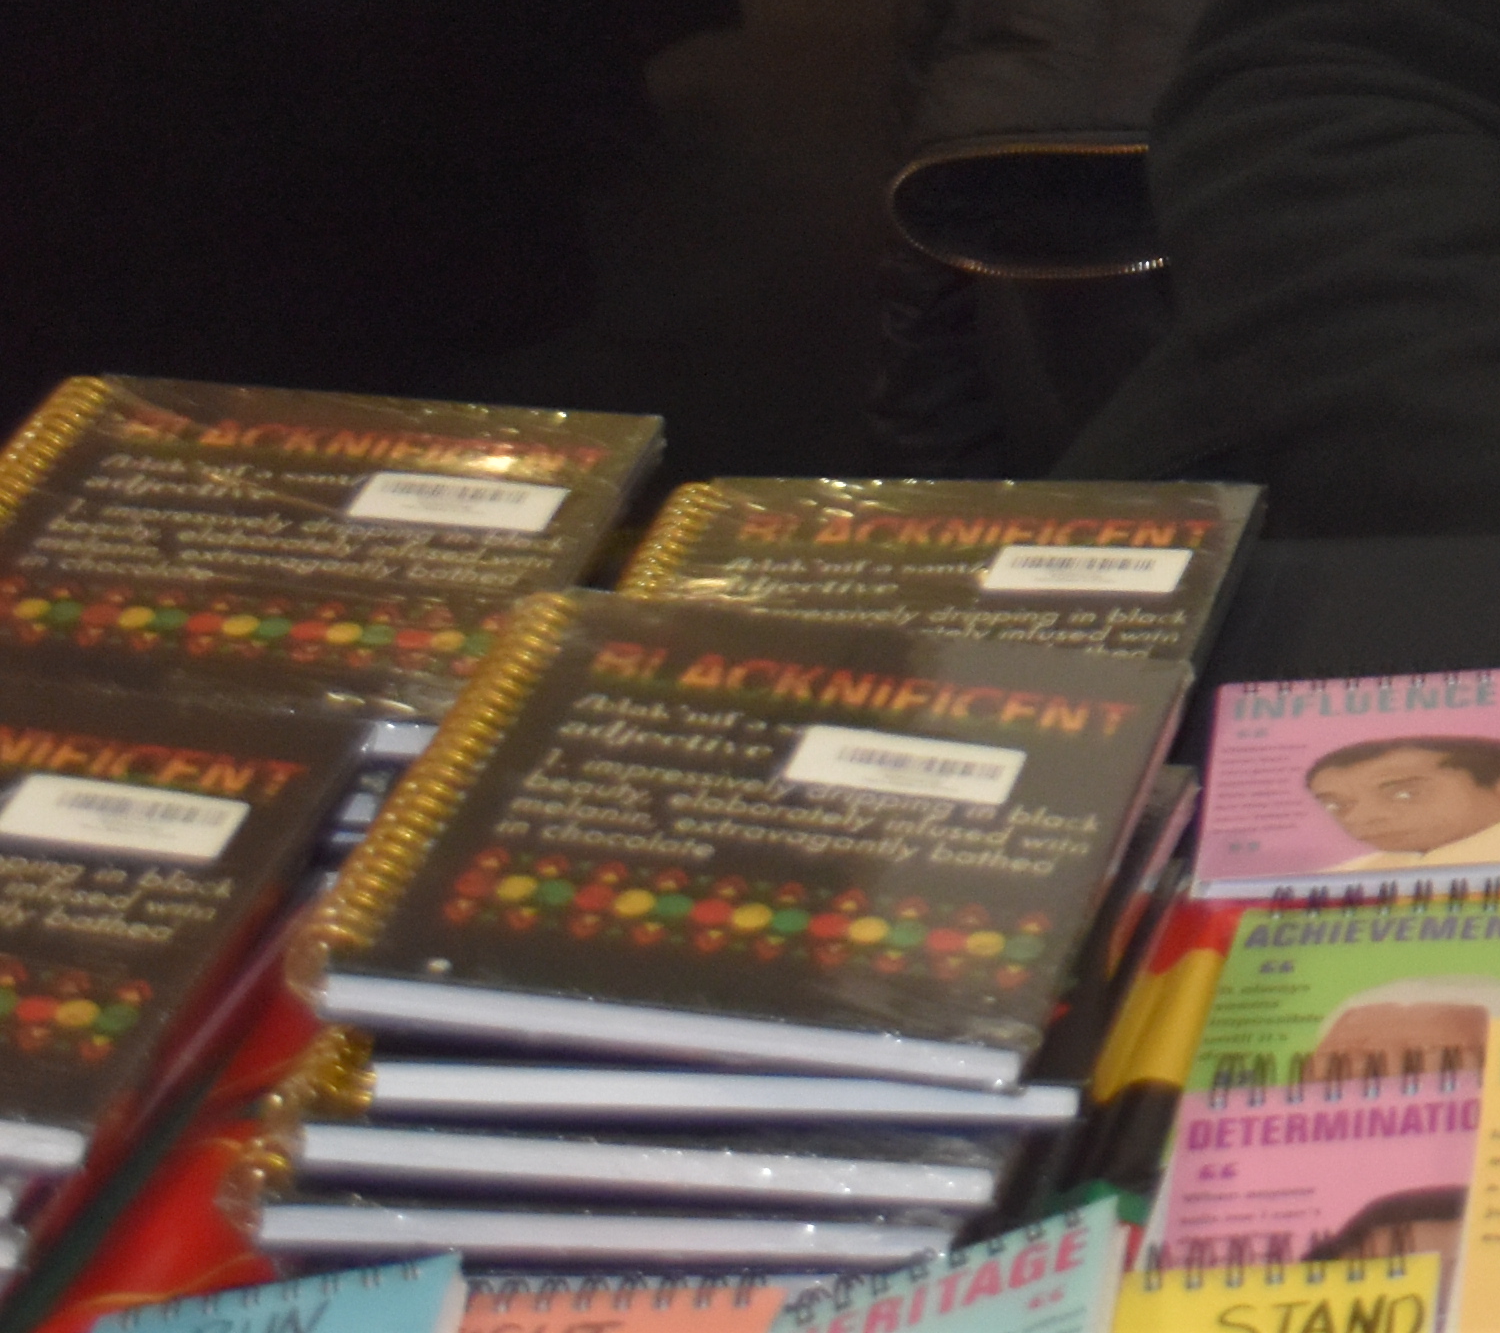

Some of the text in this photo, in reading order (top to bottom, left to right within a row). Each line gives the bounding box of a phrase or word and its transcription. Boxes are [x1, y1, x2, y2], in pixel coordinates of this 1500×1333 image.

[588, 639, 1144, 736] BLACKNIFICENT
[1232, 682, 1498, 722] INFLUENCE
[1007, 800, 1099, 834] black
